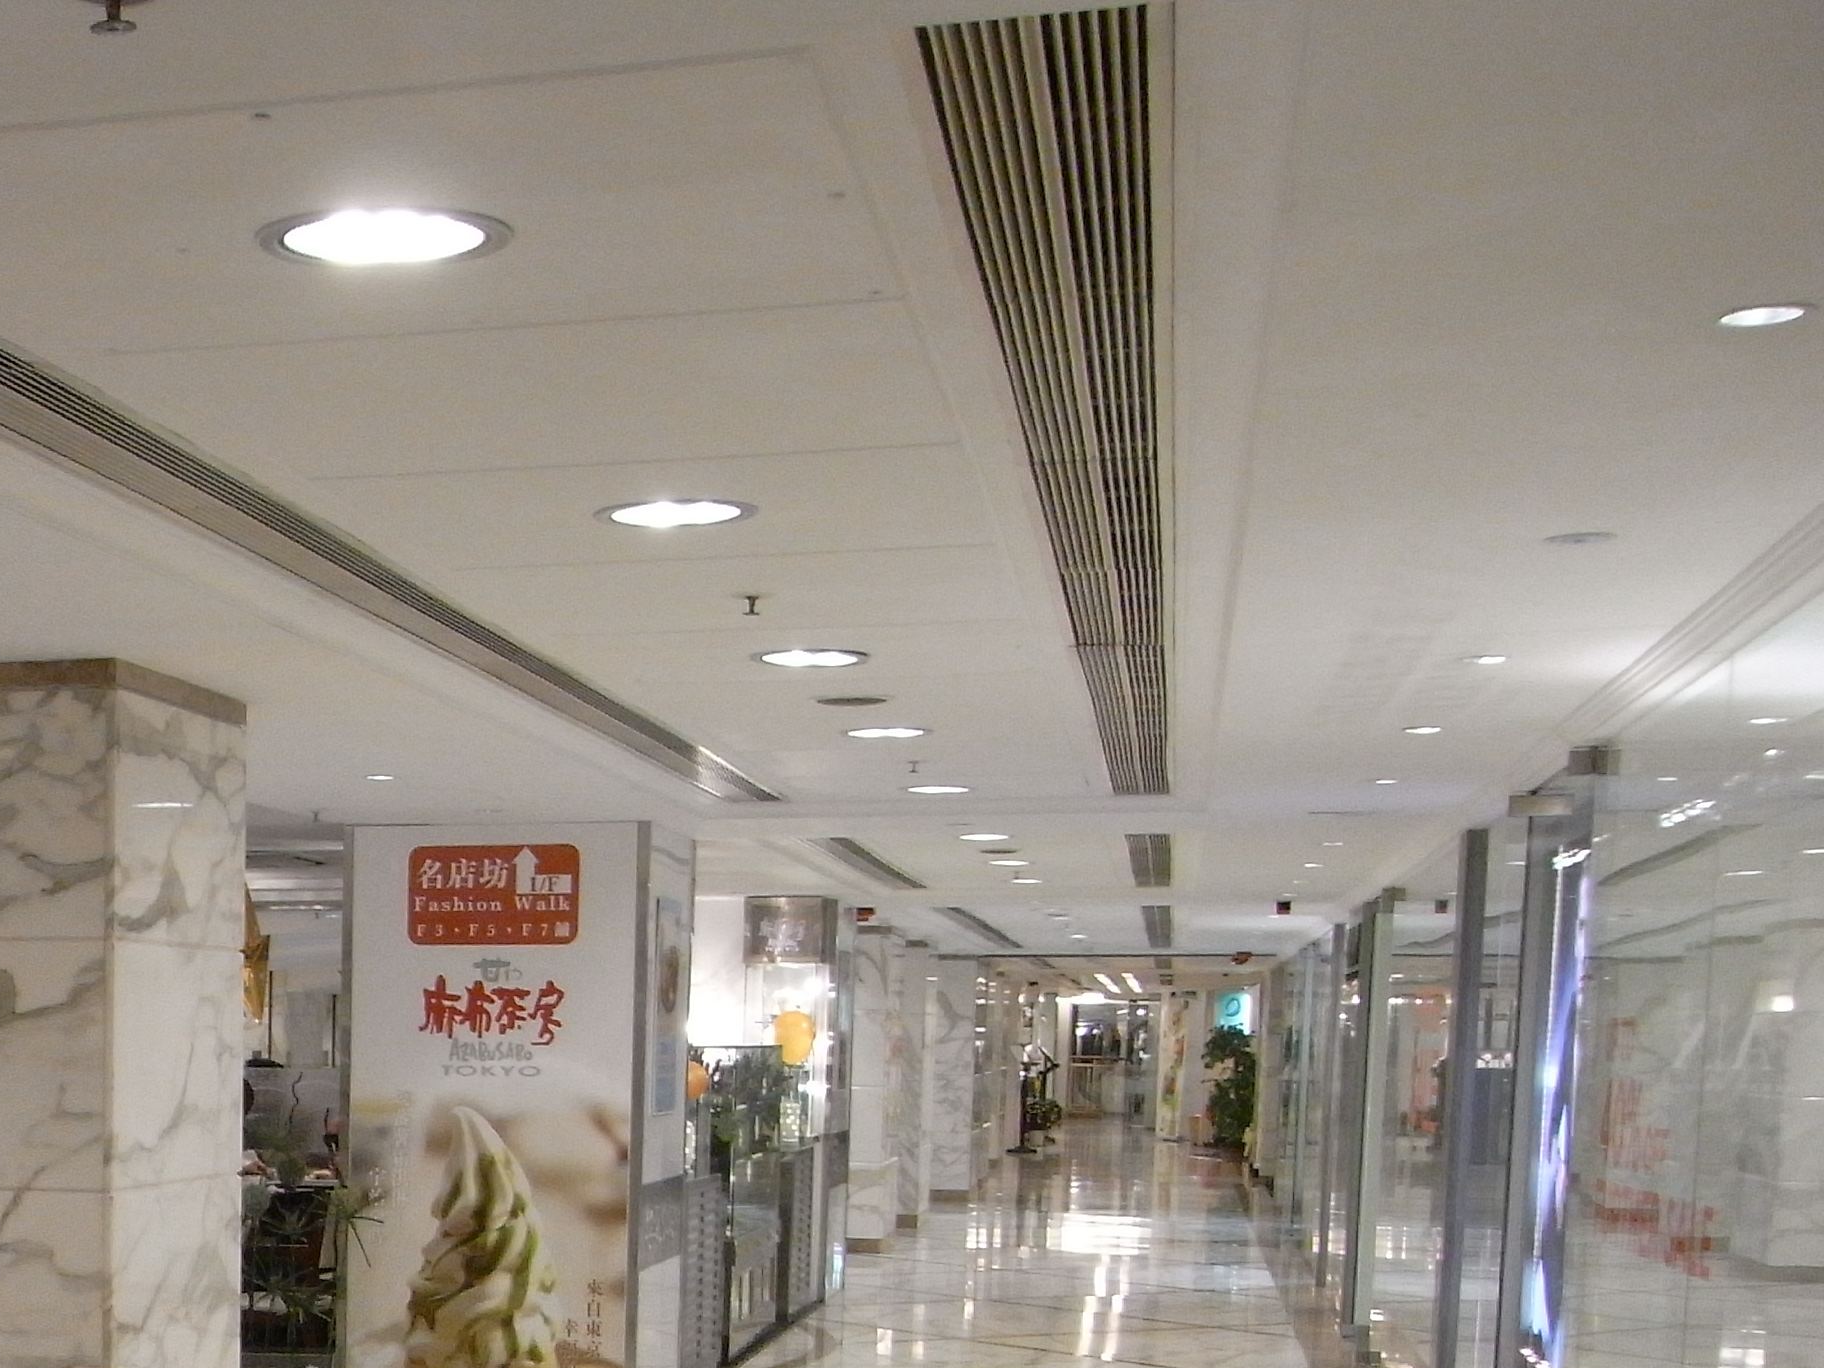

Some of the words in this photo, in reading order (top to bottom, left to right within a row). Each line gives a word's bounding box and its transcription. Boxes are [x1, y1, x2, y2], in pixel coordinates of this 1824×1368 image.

[417, 857, 509, 889] 名店坊
[413, 896, 503, 912] Fashion
[514, 895, 571, 912] Walk
[441, 1064, 542, 1078] TOKYO
